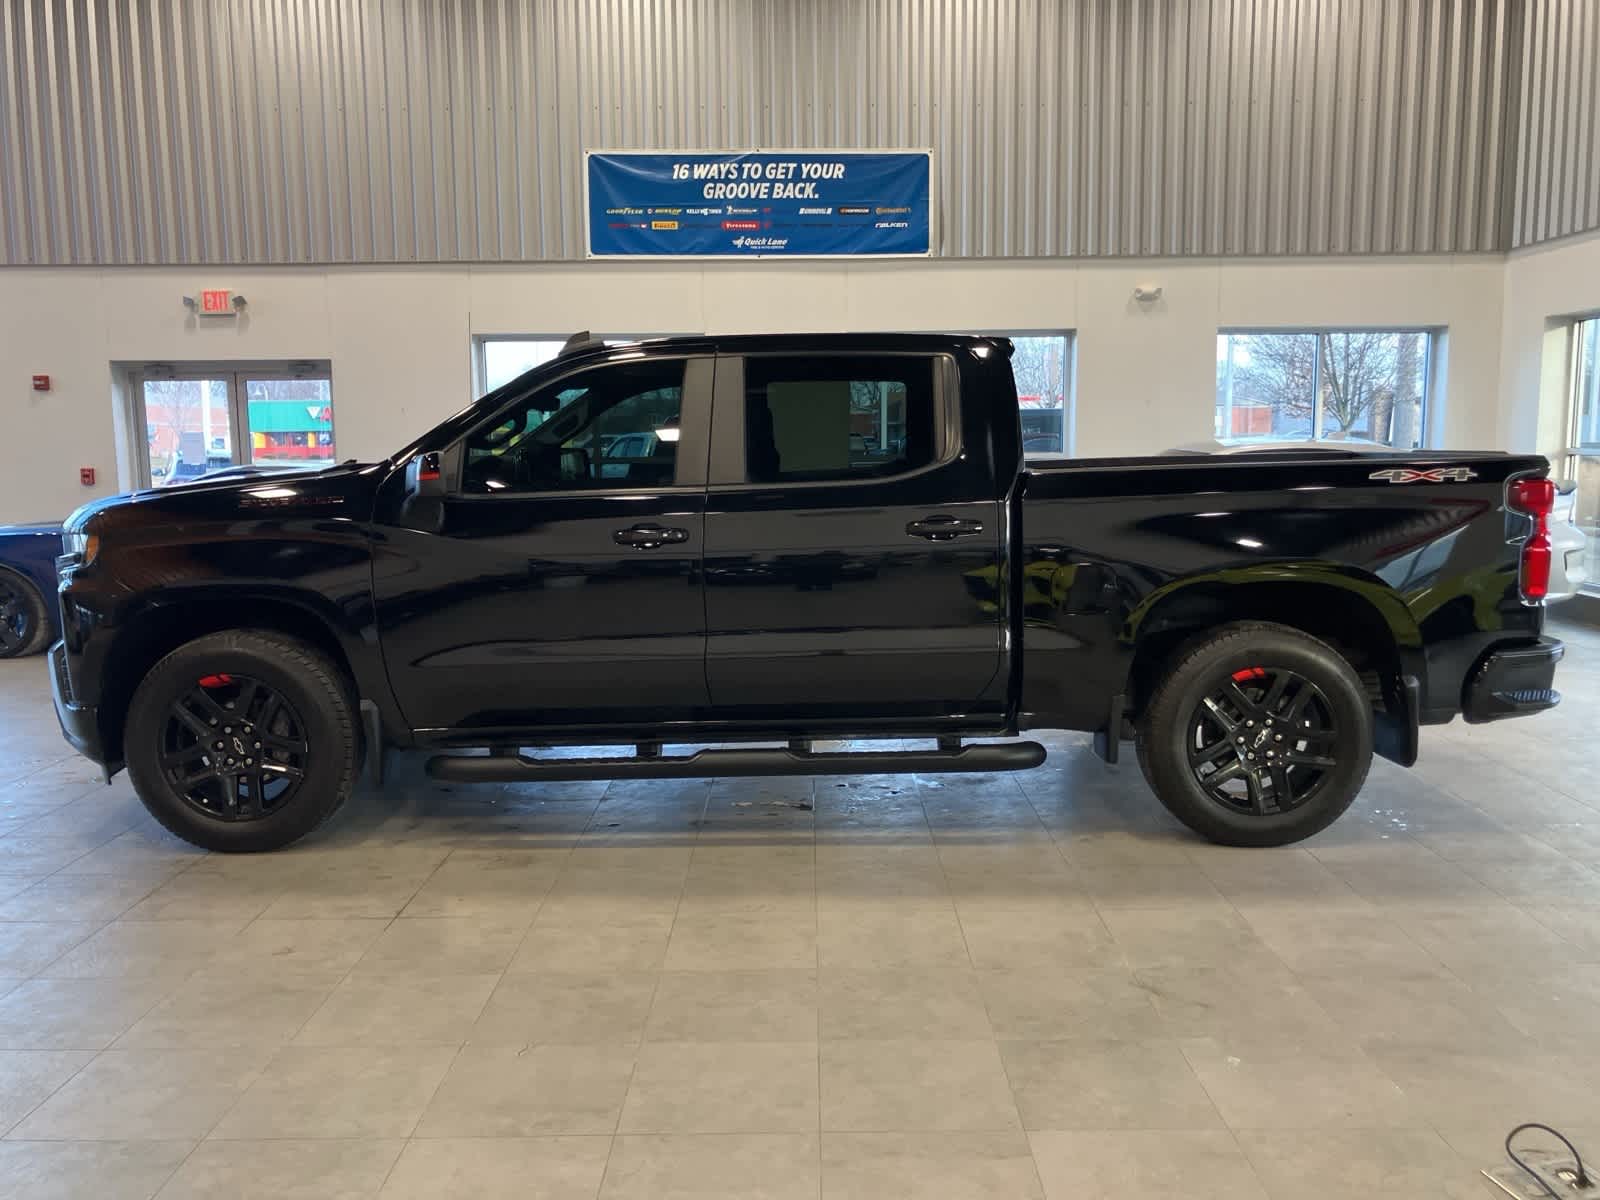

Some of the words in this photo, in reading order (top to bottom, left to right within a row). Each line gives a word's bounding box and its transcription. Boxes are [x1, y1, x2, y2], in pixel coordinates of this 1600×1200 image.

[672, 164, 689, 179] 16
[693, 163, 738, 180] WAYS
[742, 163, 762, 179] TO
[765, 163, 797, 179] GET
[801, 163, 845, 179] YOUR
[703, 183, 769, 199] GROOVE
[772, 182, 819, 199] BACK.
[744, 238, 767, 246] Quick
[767, 237, 788, 246] Lane
[203, 291, 230, 311] EXIT
